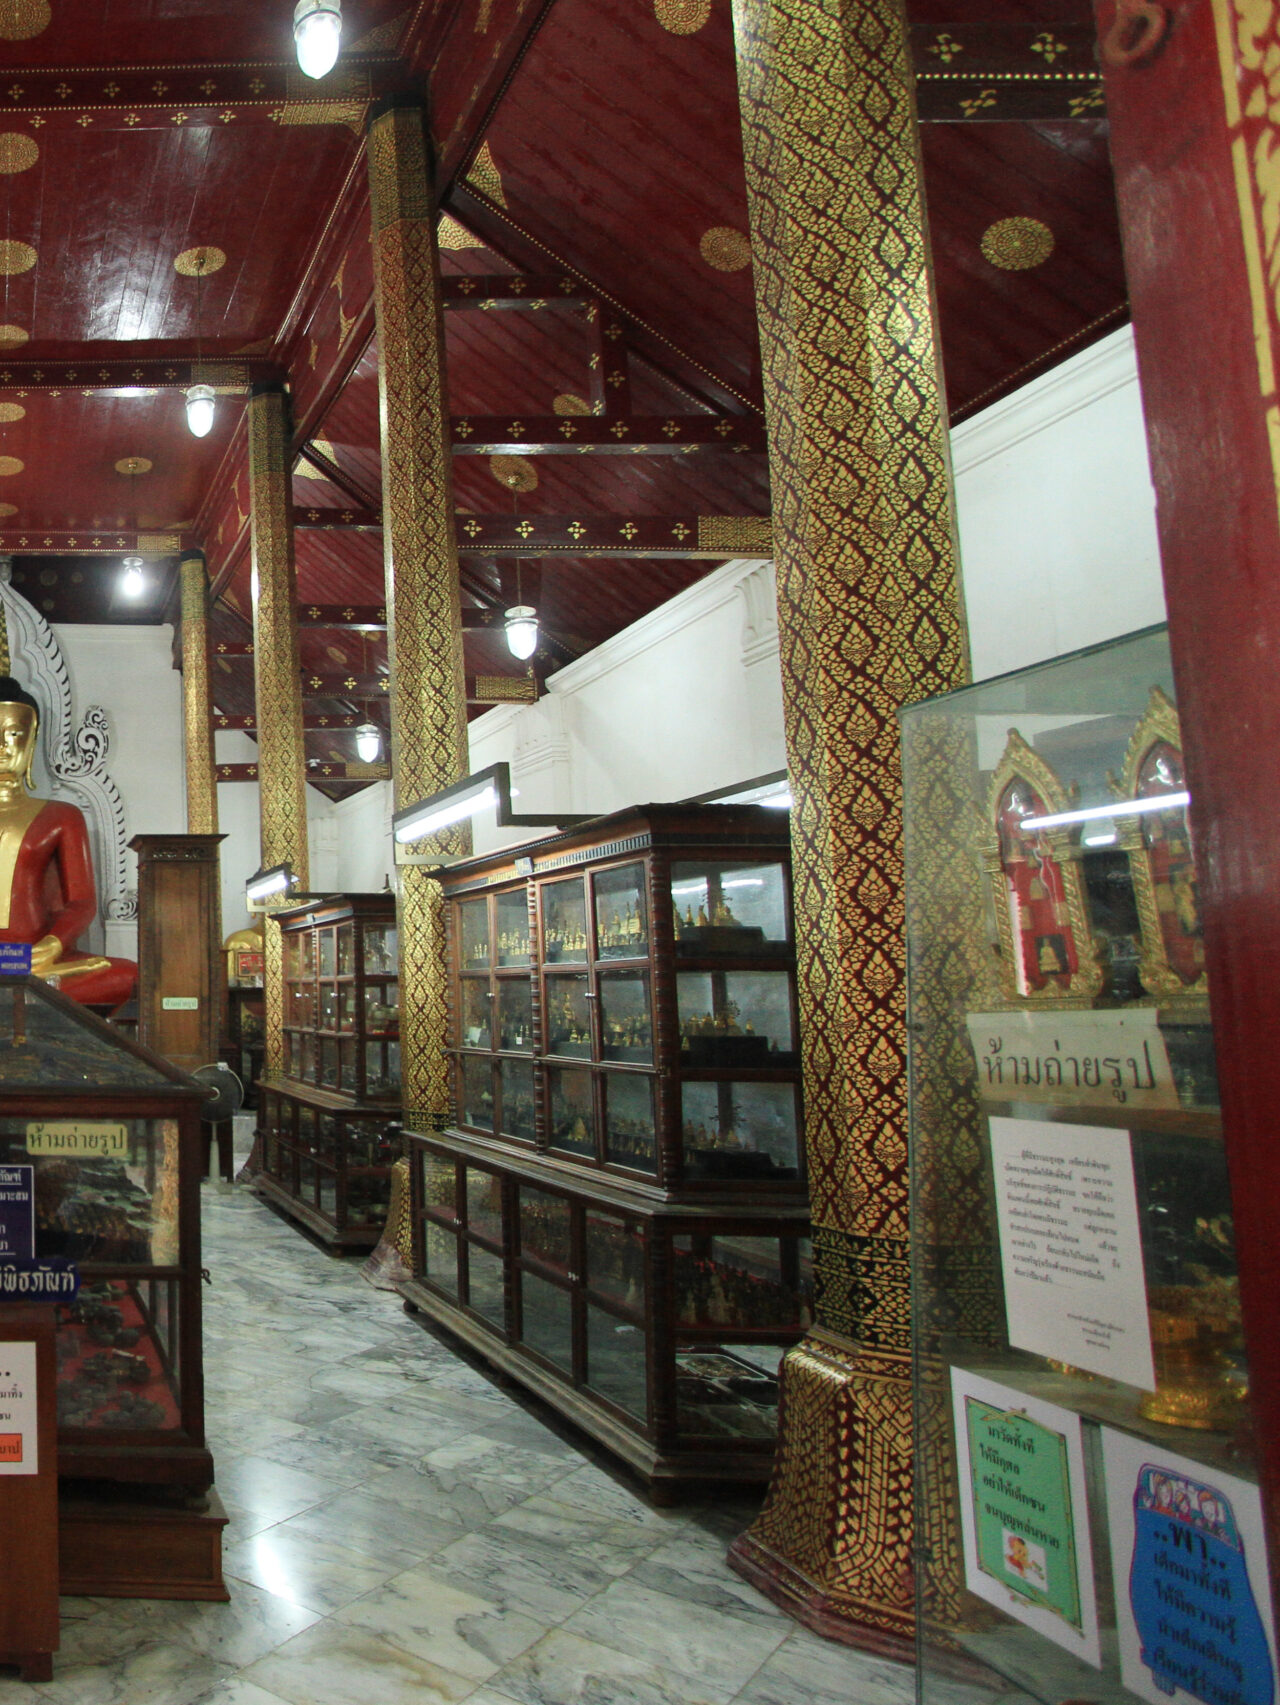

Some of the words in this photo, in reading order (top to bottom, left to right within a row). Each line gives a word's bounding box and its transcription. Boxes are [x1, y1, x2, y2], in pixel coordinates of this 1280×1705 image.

[983, 1036, 1156, 1103] ห้ามถ่ายรูป
[30, 1126, 124, 1155] ห้ามถ่ายรูป
[979, 1442, 1020, 1475] ให้มีกุศล
[988, 1424, 1035, 1455] มาวัดทั้งที
[983, 1473, 1045, 1513] อย่าให้เด็กซน
[985, 1503, 1059, 1549] จนบุญหล่นหาย
[1154, 1550, 1232, 1600] เด็กมาทั้งที
[1154, 1577, 1236, 1645] ให้มีความรู้
